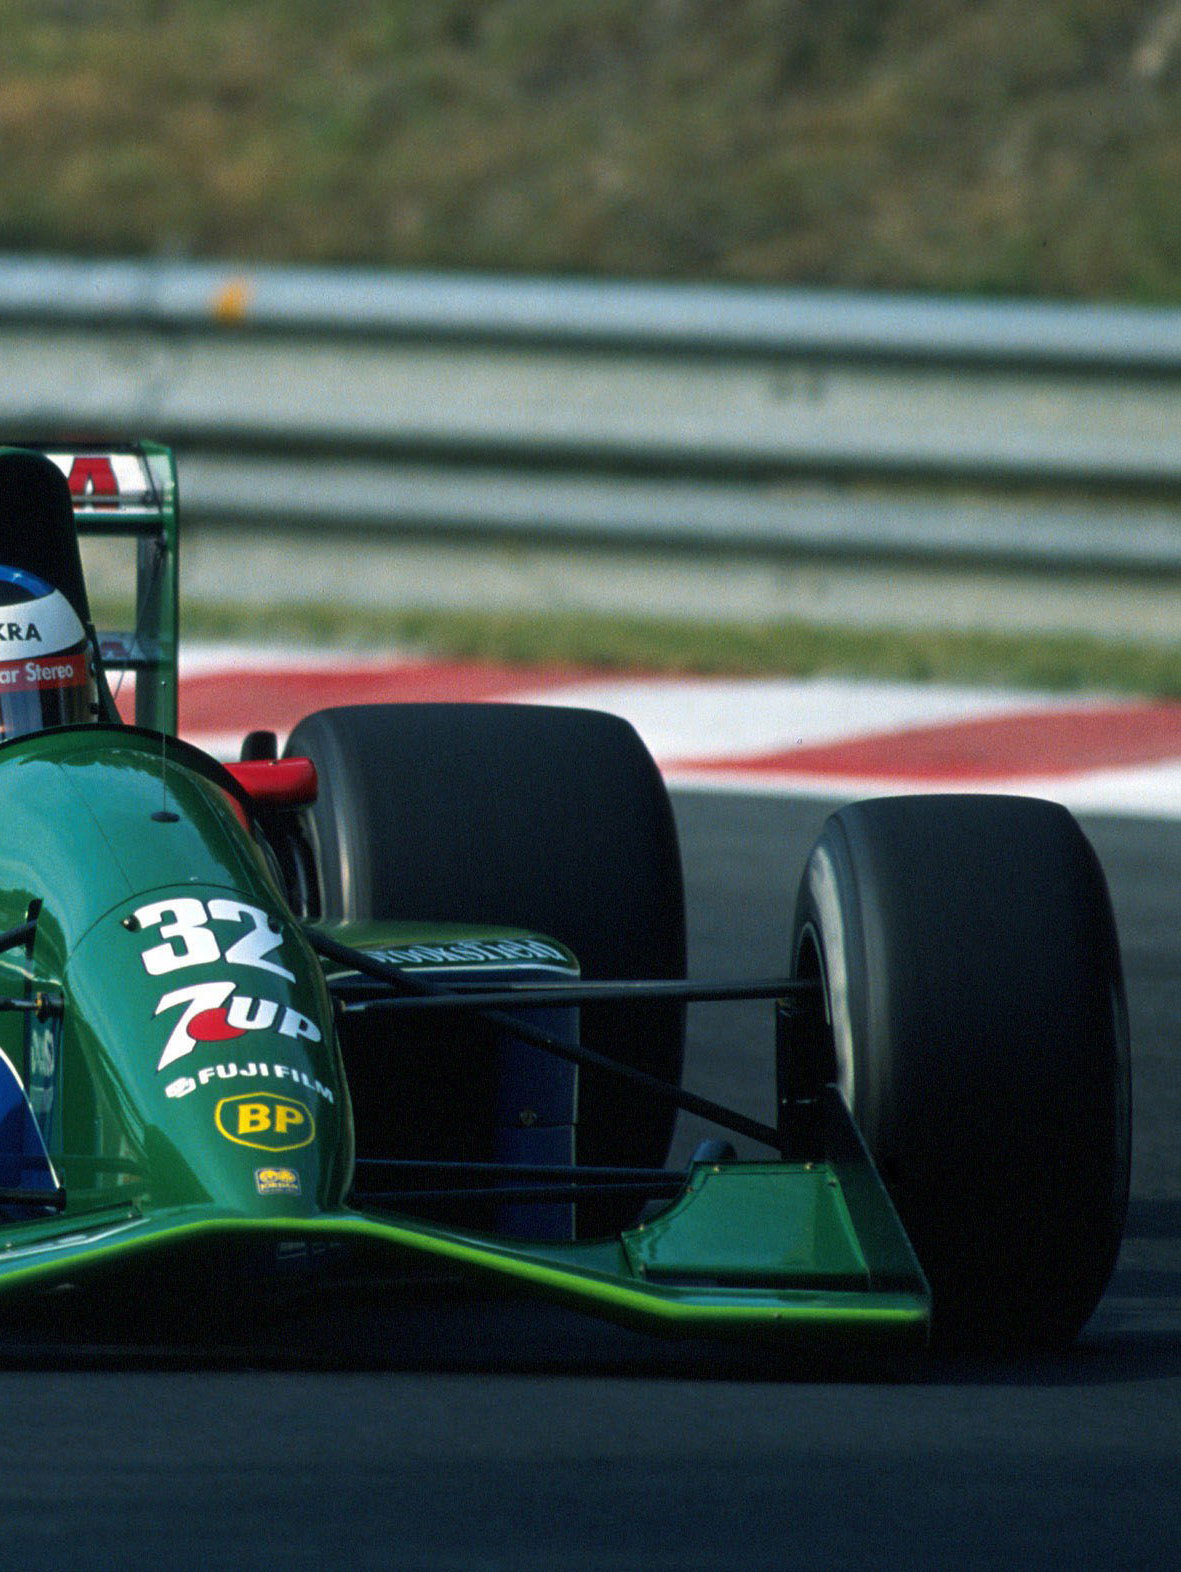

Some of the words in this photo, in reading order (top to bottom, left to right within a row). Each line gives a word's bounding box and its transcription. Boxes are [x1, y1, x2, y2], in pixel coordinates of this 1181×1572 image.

[25, 662, 74, 682] Stereo
[134, 898, 297, 984] 32
[238, 1103, 305, 1135] BP
